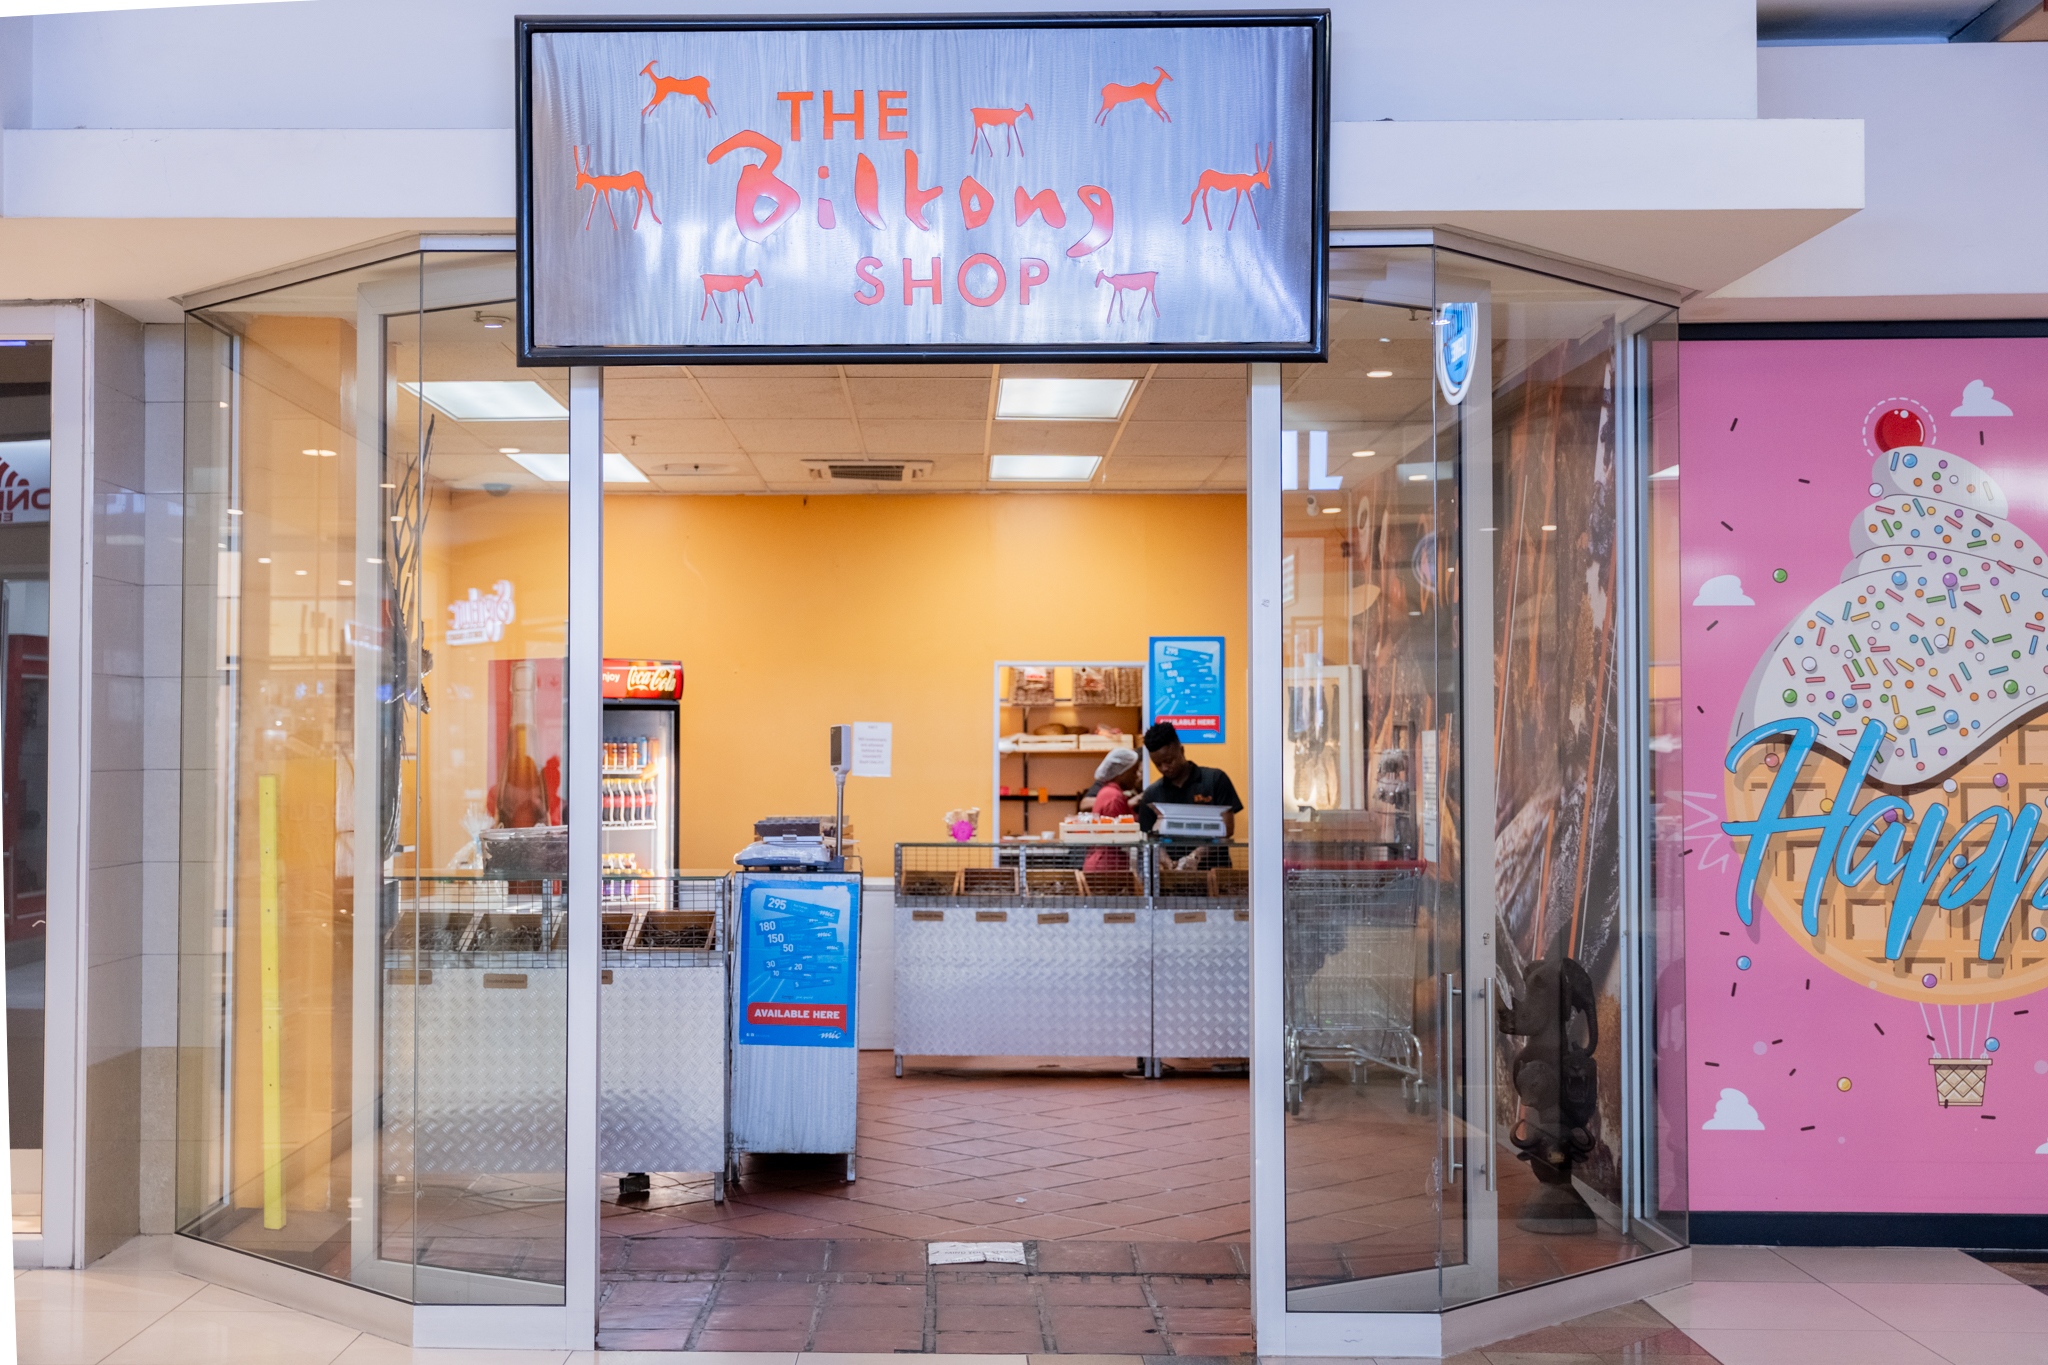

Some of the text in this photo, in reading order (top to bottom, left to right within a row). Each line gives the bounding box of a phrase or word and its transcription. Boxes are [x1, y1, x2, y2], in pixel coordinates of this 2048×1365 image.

[776, 90, 908, 141] THE
[853, 252, 1050, 308] SHOP
[626, 665, 677, 692] Coca-Cola
[767, 897, 787, 911] 295
[759, 920, 776, 932] 180
[767, 933, 784, 944] 150
[783, 944, 794, 953] 50
[766, 960, 776, 968] 30
[794, 963, 803, 971] 20
[754, 1008, 840, 1020] AVAILABLE HERE
